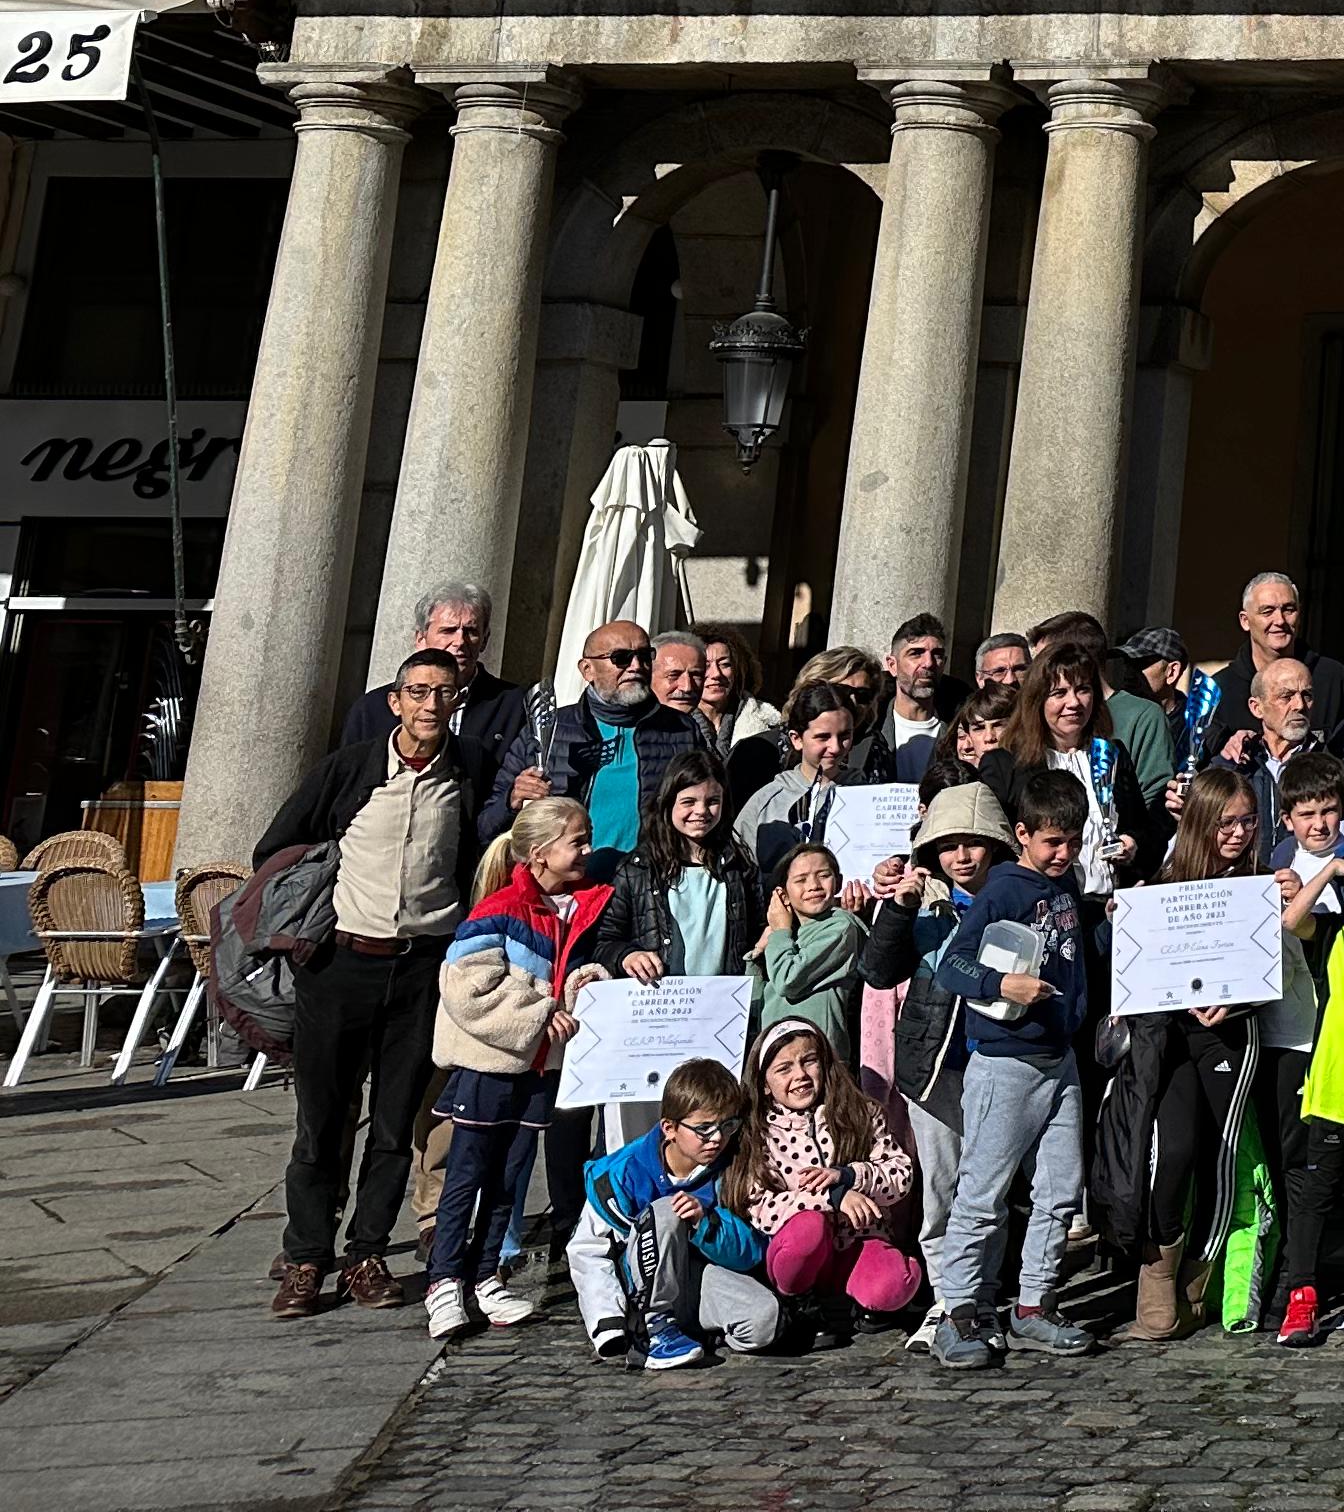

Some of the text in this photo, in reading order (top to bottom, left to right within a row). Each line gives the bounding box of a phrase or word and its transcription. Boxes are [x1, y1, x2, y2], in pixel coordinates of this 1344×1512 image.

[3, 24, 111, 85] 25
[20, 428, 241, 499] negr
[1182, 912, 1202, 922] AÑO
[632, 1008, 645, 1017] DE
[648, 1006, 668, 1015] AÑO
